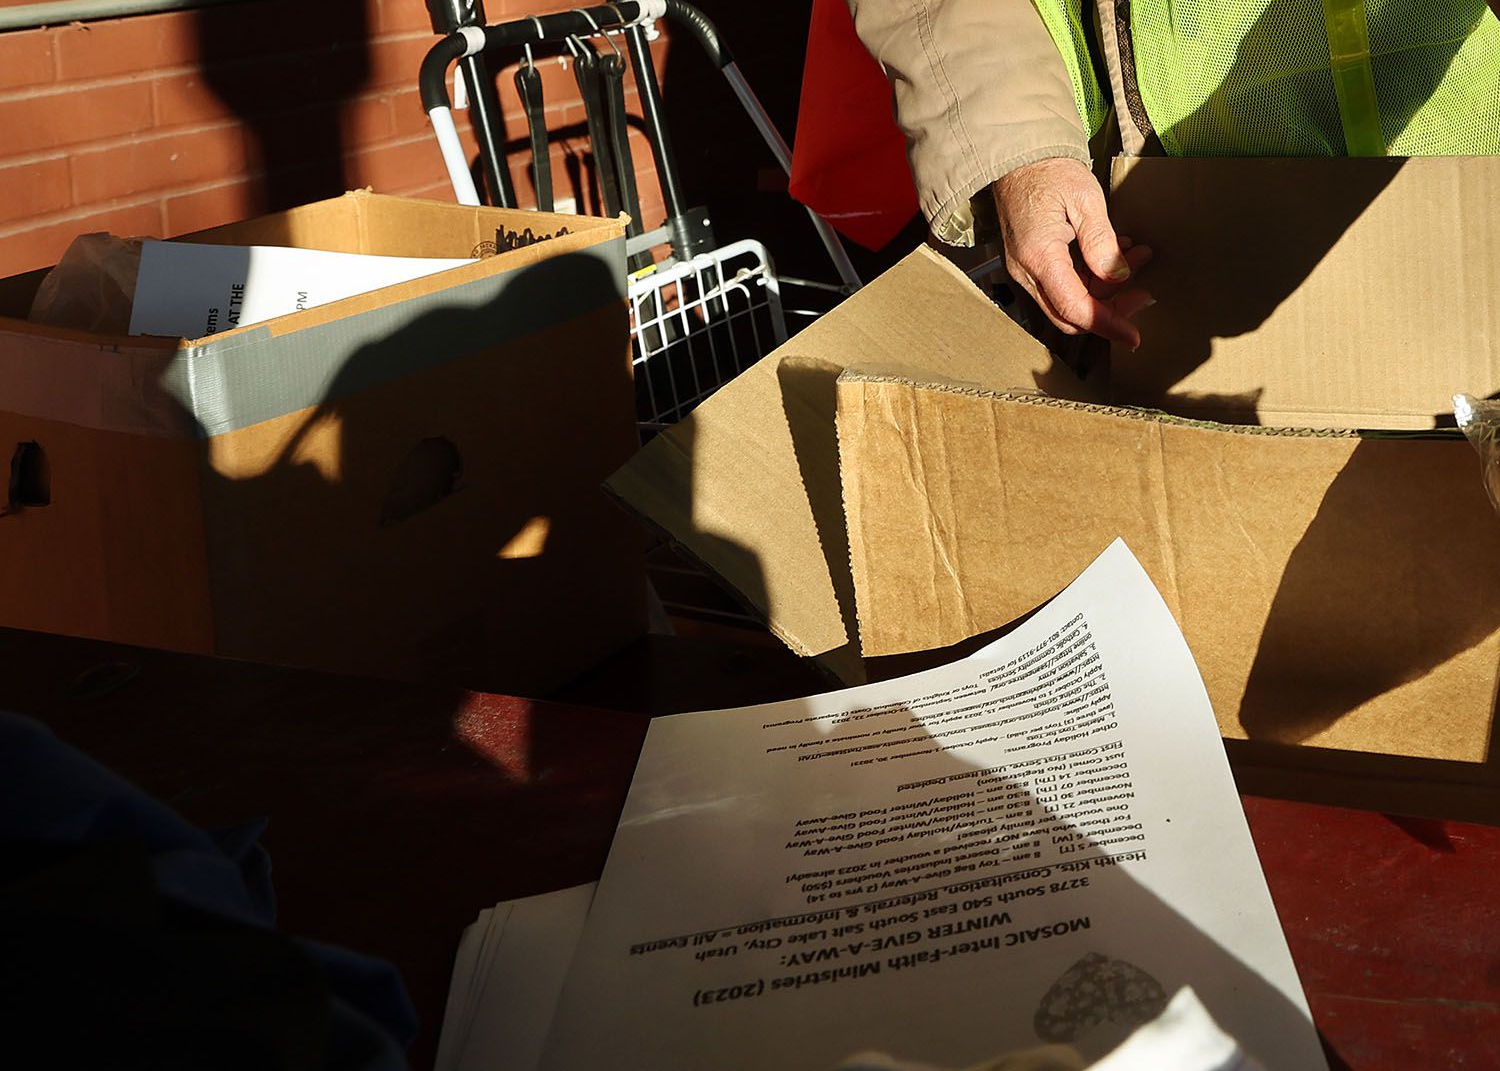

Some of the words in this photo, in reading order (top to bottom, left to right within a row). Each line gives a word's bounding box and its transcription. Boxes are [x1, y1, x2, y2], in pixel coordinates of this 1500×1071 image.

[230, 284, 244, 307] THE
[228, 309, 240, 324] AT
[1091, 722, 1118, 734] Other
[1054, 731, 1089, 743] Holiday
[1004, 740, 1052, 753] Programs:
[1100, 742, 1123, 752] First
[1042, 754, 1067, 763] First
[1068, 748, 1099, 758] Come
[1105, 752, 1125, 761] Just
[1008, 759, 1041, 769] Serve,
[1047, 763, 1066, 771] (No
[1069, 758, 1102, 769] Come!
[1074, 762, 1128, 776] December
[948, 770, 980, 782] Items
[979, 765, 1008, 777] Until
[897, 777, 947, 792] Depleted
[1034, 775, 1056, 785] [Th]
[1076, 772, 1130, 786] December
[1005, 781, 1029, 790] 8:30
[1036, 784, 1058, 794] [Th]
[1060, 782, 1074, 790] 07
[1077, 782, 1132, 795] November
[1006, 791, 1030, 799] 8:30
[1036, 794, 1058, 805] [Th]
[1060, 792, 1074, 800] 30
[1080, 792, 1135, 805] November
[1006, 800, 1031, 809] 8:30
[1044, 804, 1059, 814] [T]
[1106, 804, 1129, 812] One
[859, 808, 887, 818] Food
[1005, 811, 1023, 819] am
[1059, 808, 1104, 820] voucher
[1113, 814, 1131, 822] For
[795, 813, 857, 827] Give-Away
[859, 818, 887, 828] Food
[1000, 820, 1036, 831] family
[1037, 815, 1058, 824] per
[1080, 818, 1111, 826] those
[794, 823, 856, 837] Give-Away
[857, 828, 885, 839] Food
[957, 826, 998, 840] please!
[1022, 828, 1050, 837] have
[1052, 824, 1077, 832] who
[1086, 823, 1143, 837] December
[784, 834, 854, 849] Give-A-Way
[875, 835, 903, 846] Food
[994, 833, 1020, 844] NOT
[1052, 834, 1074, 844] [W]
[1087, 834, 1145, 849] December
[803, 841, 873, 856] Give-A-Way
[943, 839, 992, 854] received
[1012, 842, 1030, 850] am
[1059, 844, 1075, 855] [T]
[883, 852, 931, 865] voucher
[955, 848, 1000, 862] Deseret
[1012, 853, 1031, 861] am
[1094, 850, 1147, 867] Health
[838, 864, 867, 875] 2023
[894, 858, 952, 874] Industries
[954, 864, 976, 873] Bag
[978, 859, 1000, 868] Toy
[1055, 861, 1090, 872] Kits,
[785, 869, 836, 883] already!
[836, 871, 891, 886] Vouchers
[881, 869, 952, 889] Give-A-Way
[801, 880, 833, 893] ($50)
[845, 886, 863, 896] yrs
[866, 883, 878, 893] (2
[1049, 877, 1090, 893] 3278
[806, 894, 825, 904] 14)
[863, 889, 939, 912] Referrals
[997, 886, 1046, 903] South
[962, 896, 993, 911] 540
[923, 903, 958, 919] East
[735, 909, 840, 935] Information
[869, 912, 919, 930] South
[927, 912, 1012, 939] WINTER
[831, 923, 865, 937] Salt
[1004, 917, 1091, 946] MOSAIC
[691, 930, 719, 944] All
[787, 930, 827, 944] Lake
[629, 935, 689, 955] Events
[744, 938, 782, 950] City,
[779, 931, 922, 967] GIVE-A-WAY:
[695, 945, 738, 962] Utah
[888, 937, 1000, 970] Inter-Faith
[771, 962, 881, 989] Ministries
[693, 979, 765, 1007] (2023)
